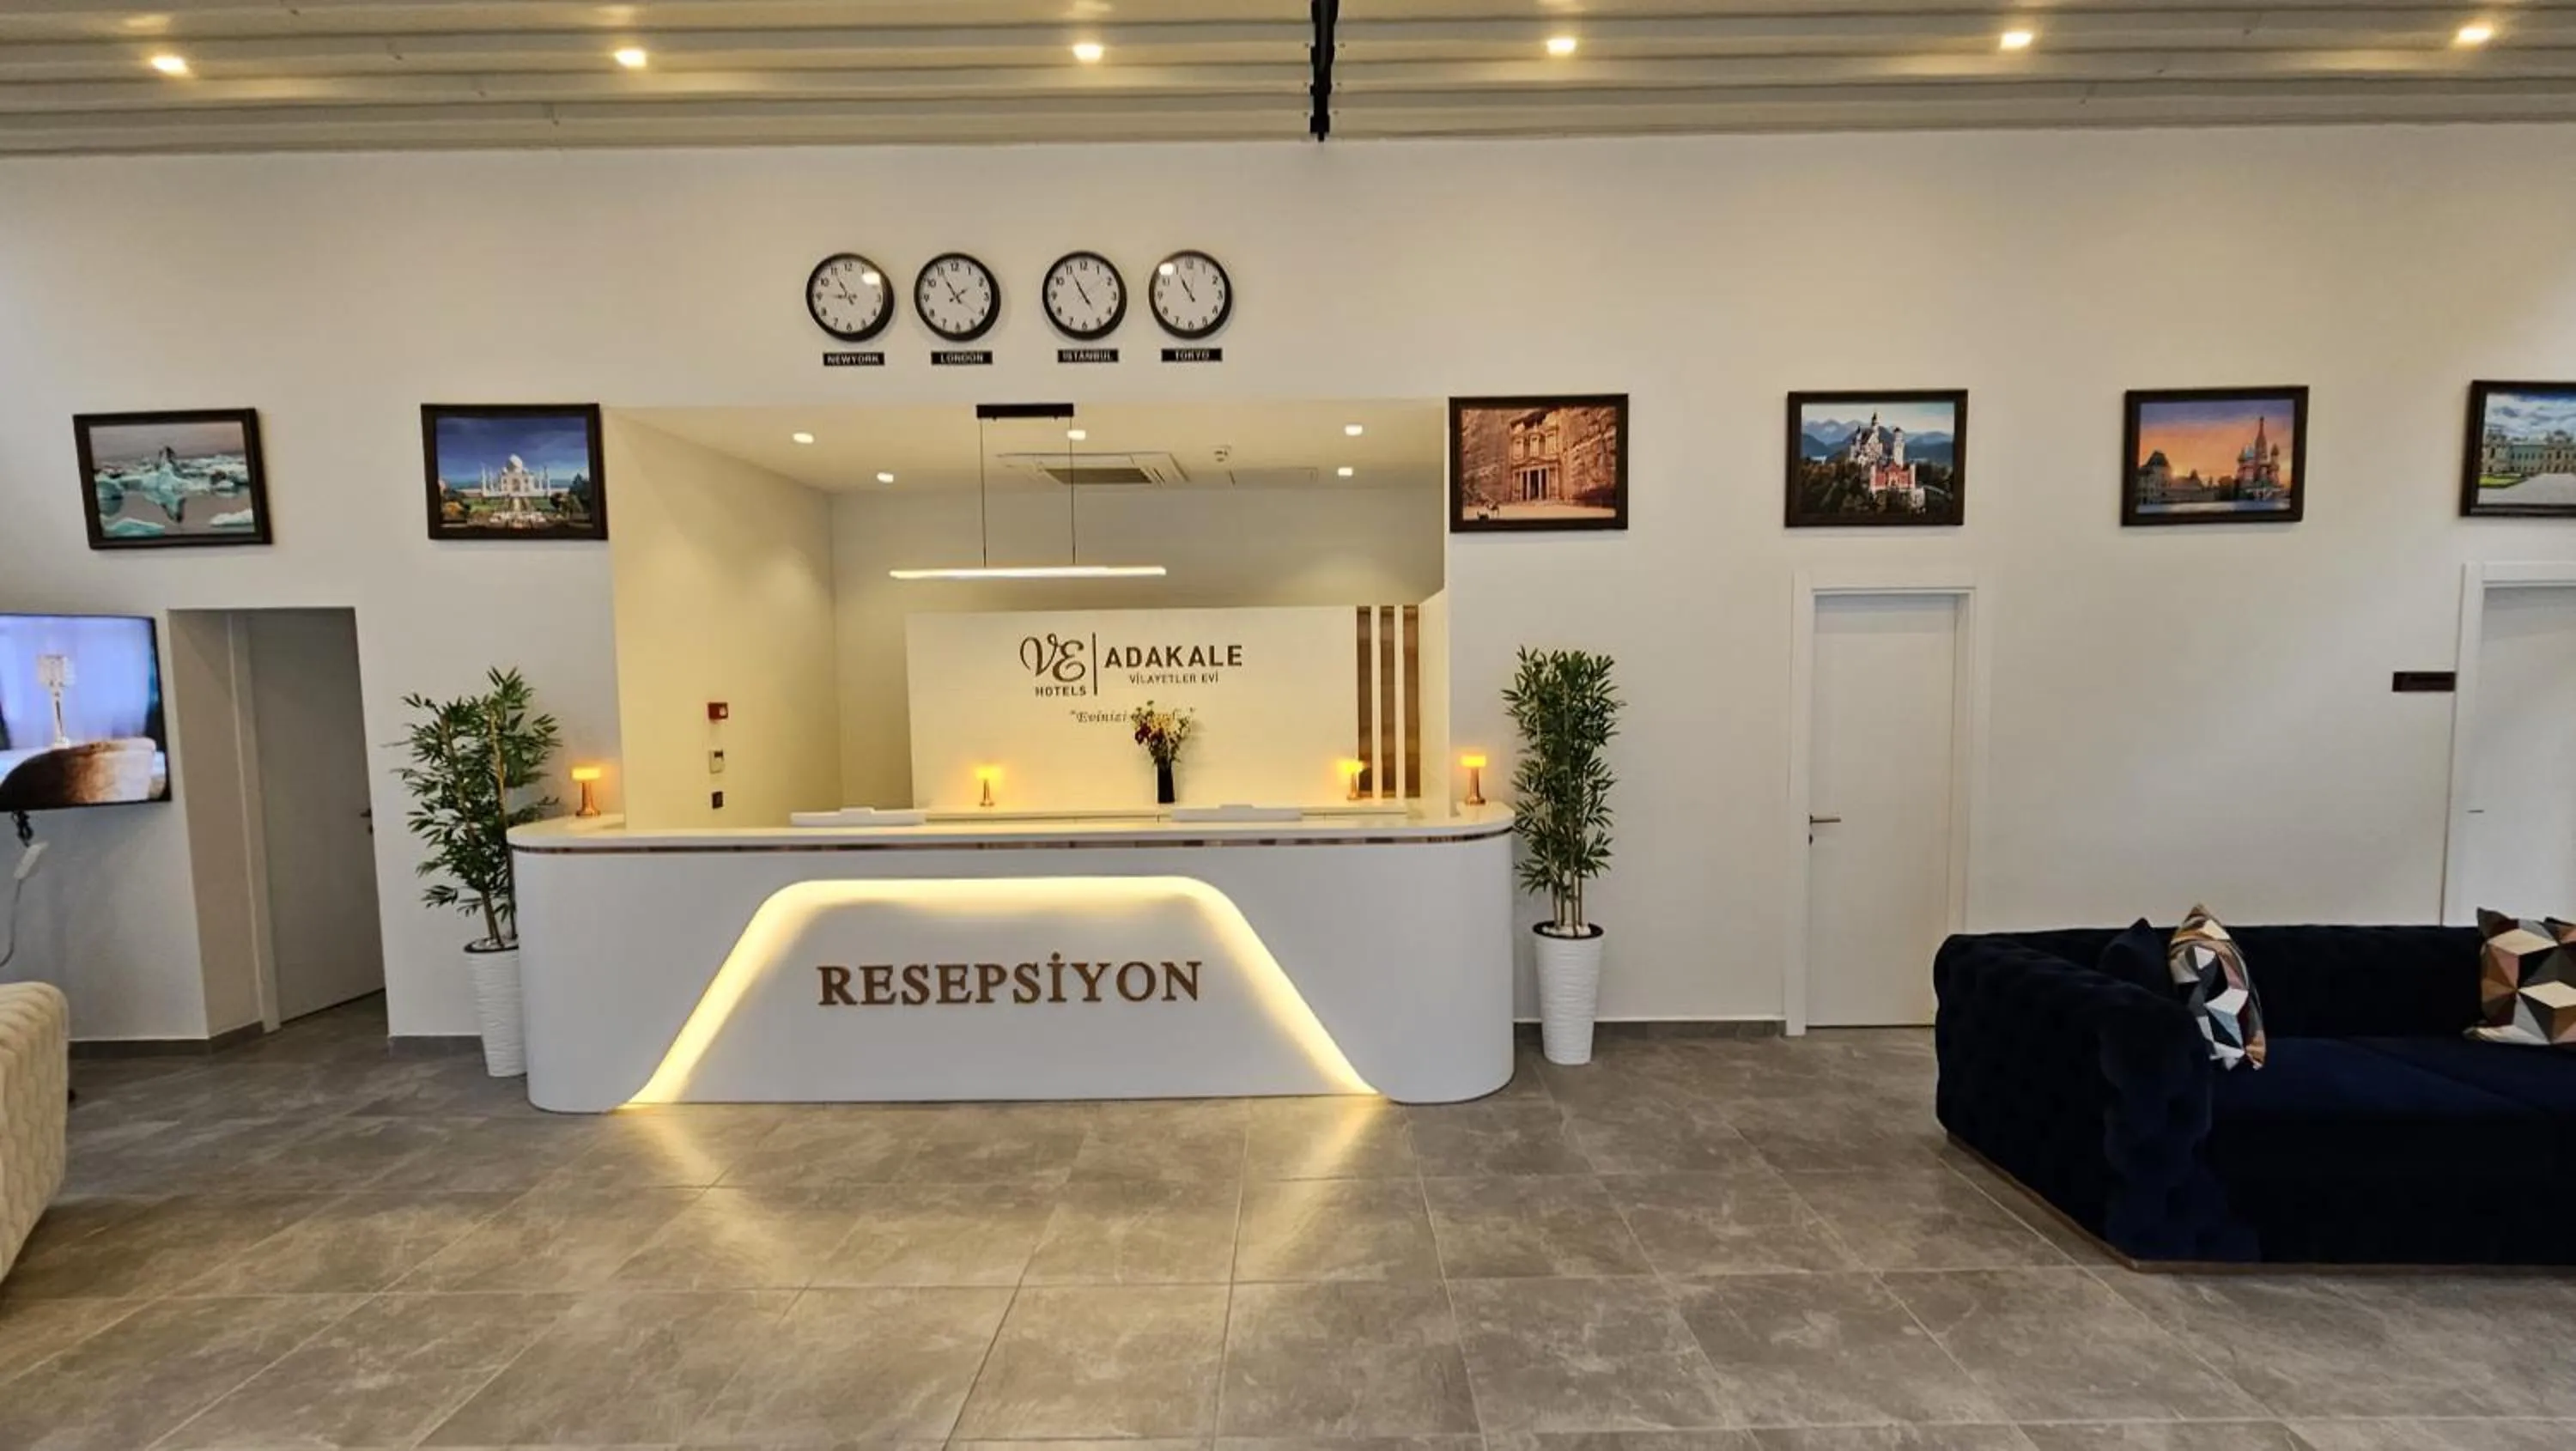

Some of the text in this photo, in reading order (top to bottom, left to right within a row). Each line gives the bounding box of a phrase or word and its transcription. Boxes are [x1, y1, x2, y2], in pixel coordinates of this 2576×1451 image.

[940, 353, 983, 362] LONDON
[1176, 350, 1210, 360] TOKYO
[1019, 633, 1086, 683] VE
[1104, 645, 1243, 668] ADAKALE
[1129, 671, 1218, 684] VİLAYETLER EVİ
[1035, 686, 1086, 697] HOTELS
[817, 952, 1202, 1005] RESEPSİYON
